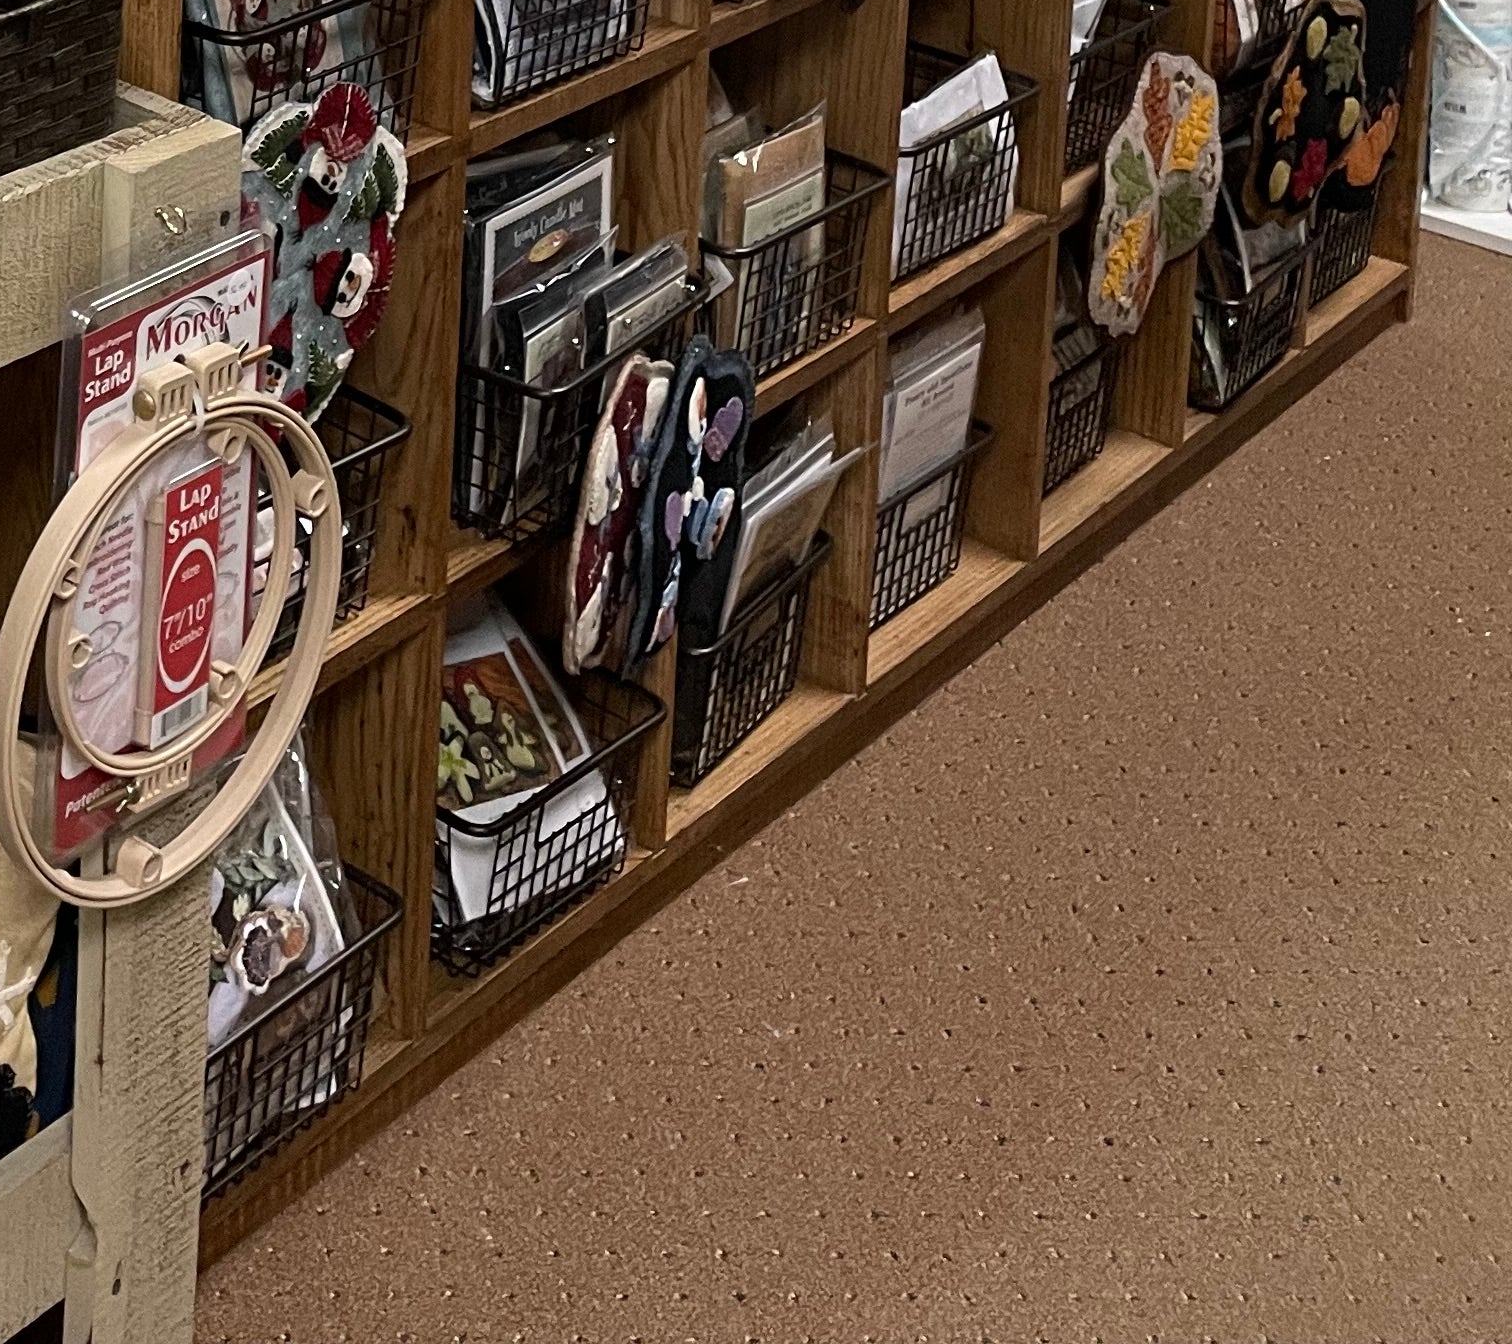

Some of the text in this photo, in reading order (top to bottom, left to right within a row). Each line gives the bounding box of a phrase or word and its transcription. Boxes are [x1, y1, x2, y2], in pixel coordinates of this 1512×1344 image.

[146, 286, 257, 361] MORGAN
[94, 349, 124, 377] Lap
[84, 362, 132, 403] Stand
[180, 483, 211, 513] LAP
[181, 564, 201, 584] size
[163, 592, 214, 641] 7"/10"
[168, 626, 205, 654] combo
